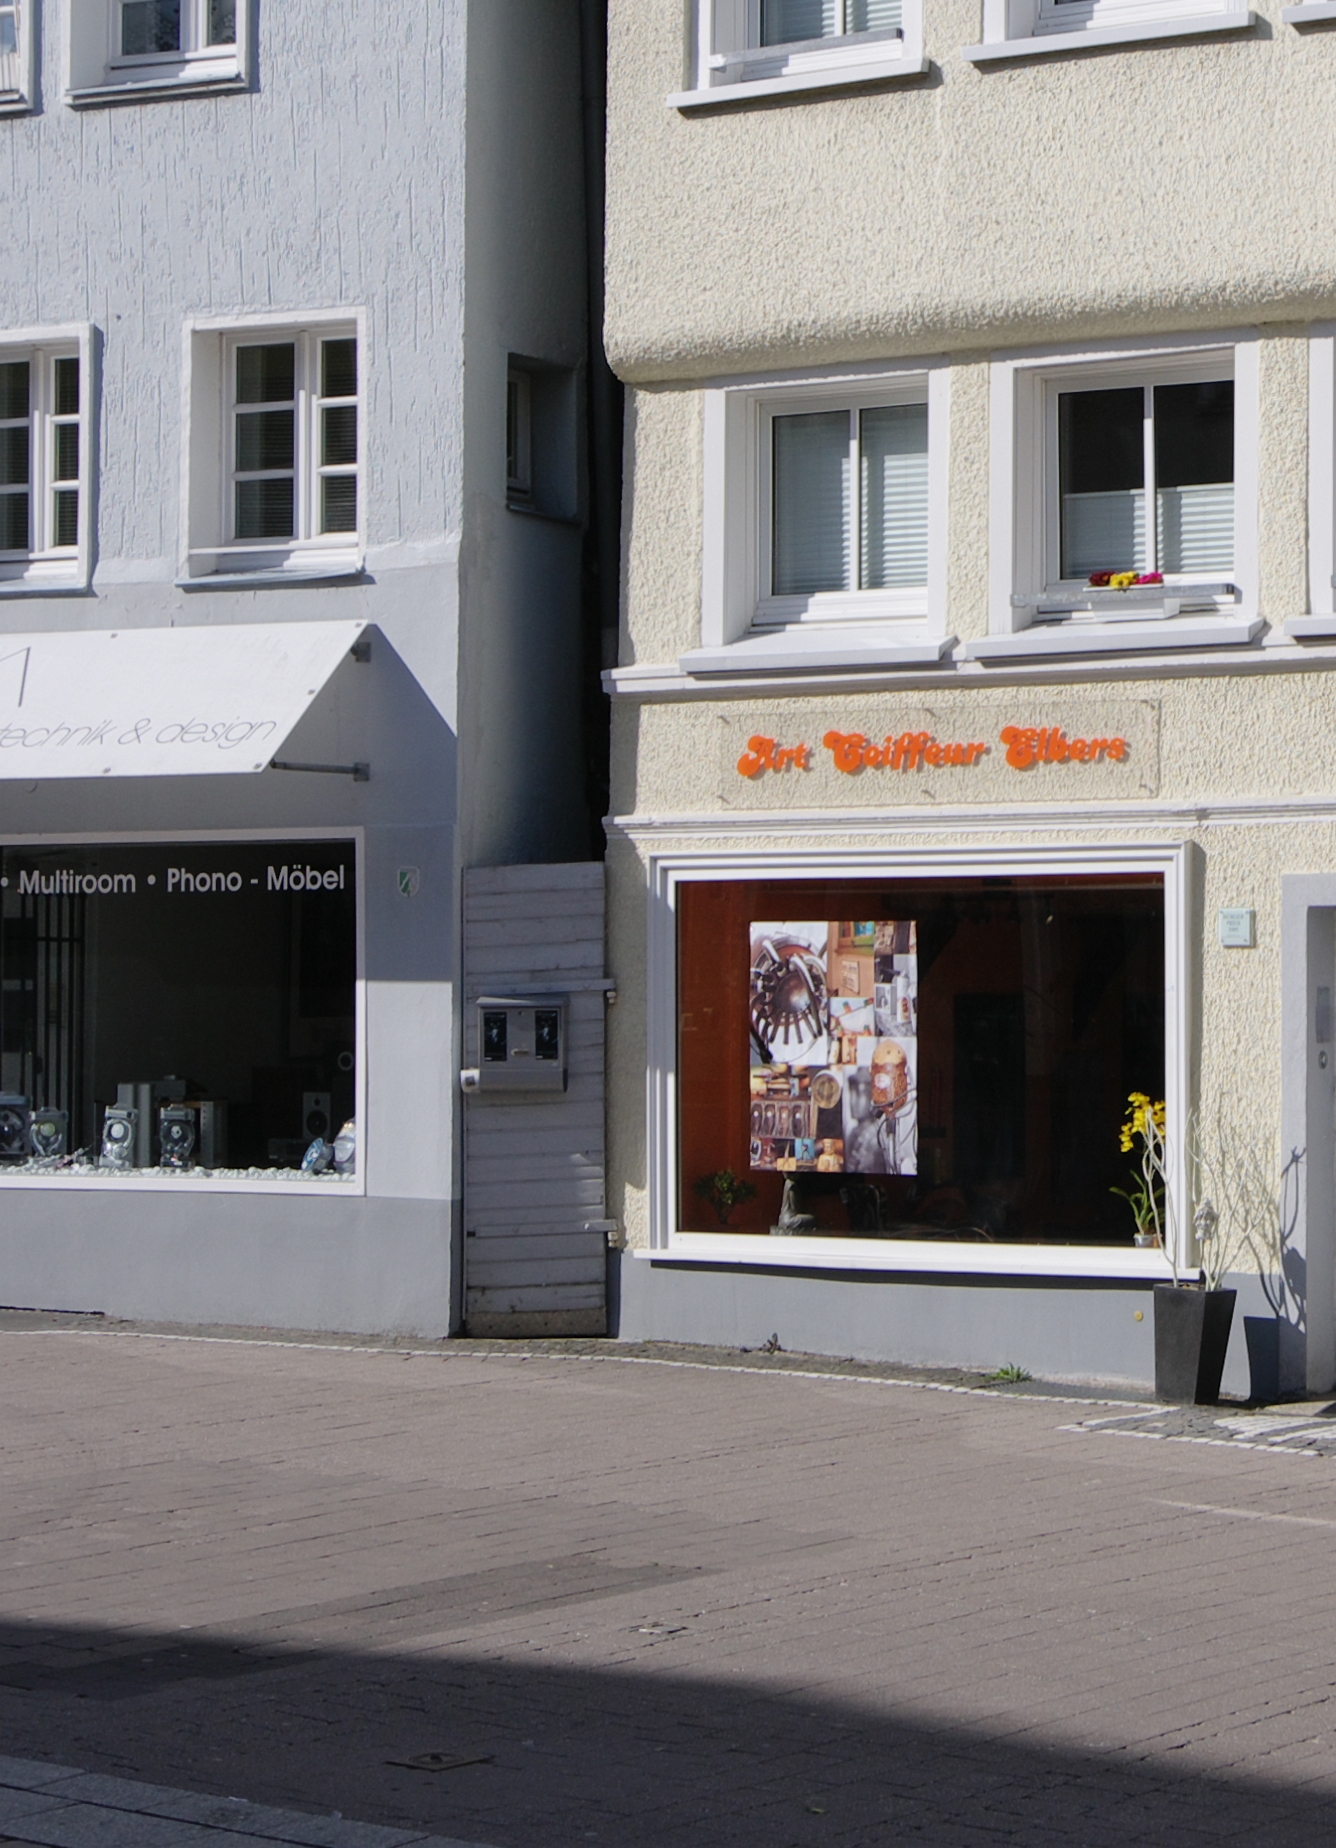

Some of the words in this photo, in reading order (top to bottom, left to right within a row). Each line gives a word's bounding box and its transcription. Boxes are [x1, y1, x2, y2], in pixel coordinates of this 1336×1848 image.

[118, 717, 152, 745] &
[156, 716, 277, 750] design
[737, 735, 807, 776] Art
[822, 730, 985, 772] Coiffeur
[1000, 725, 1126, 768] Elbers
[19, 869, 136, 894] Multiroom
[167, 867, 242, 893] Phono
[266, 864, 345, 891] Möbel
